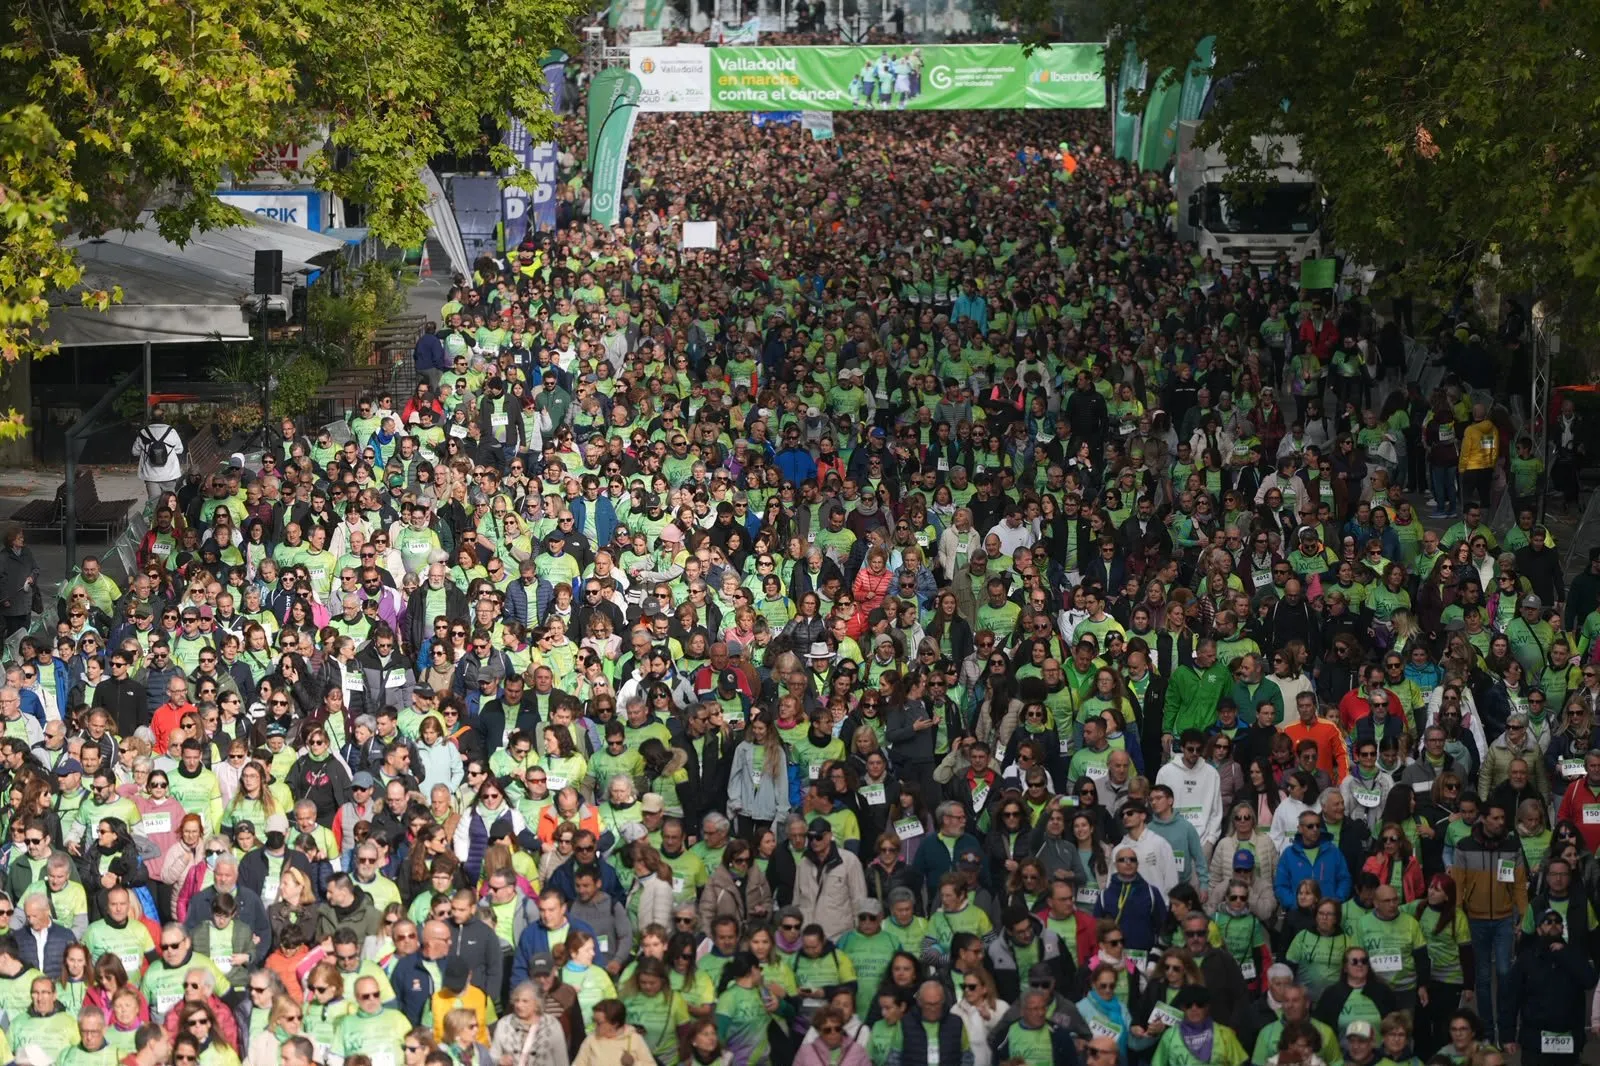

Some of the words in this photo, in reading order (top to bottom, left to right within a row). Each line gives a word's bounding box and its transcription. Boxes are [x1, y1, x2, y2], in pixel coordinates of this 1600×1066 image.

[717, 57, 797, 71] Valladolid
[718, 76, 738, 86] en
[742, 72, 800, 86] marcha
[1051, 71, 1099, 82] Iberdrola
[718, 88, 768, 101] contra
[771, 87, 786, 101] el
[789, 87, 841, 101] cáncer
[1255, 573, 1270, 582] 4012
[898, 823, 920, 834] 32152
[1368, 937, 1381, 950] XV
[1373, 956, 1399, 964] 41712
[1546, 1037, 1573, 1045] 27507
